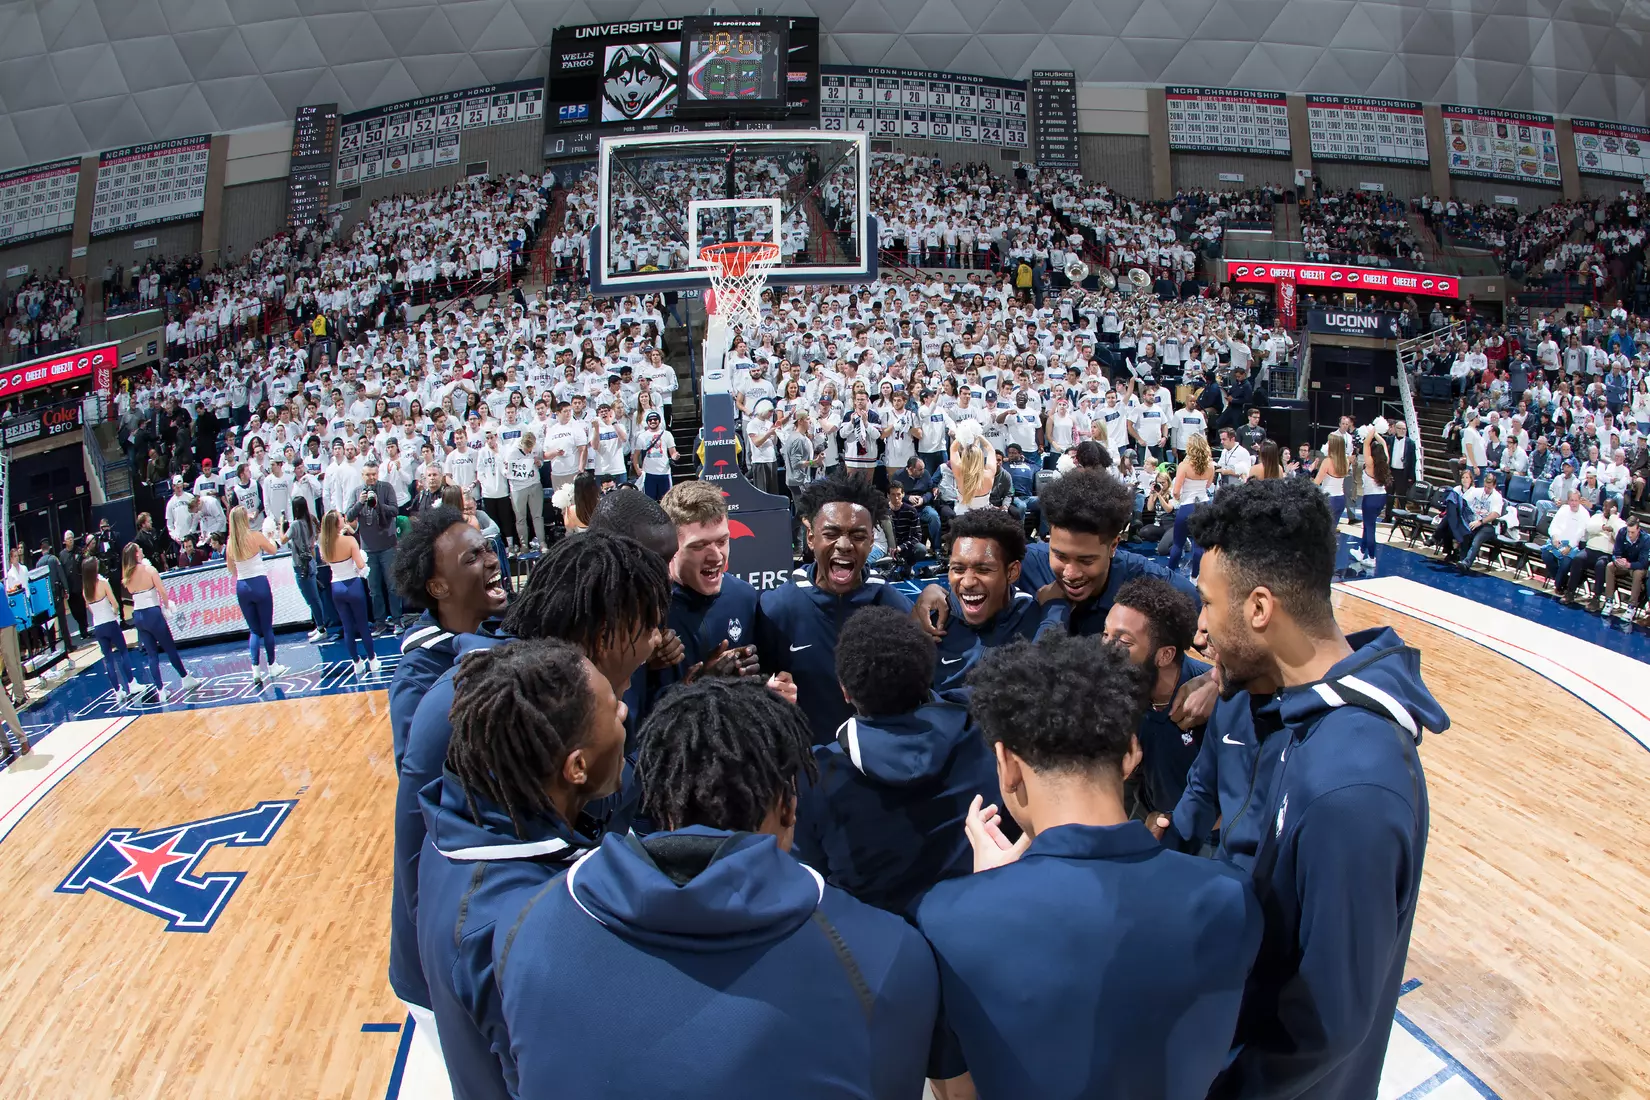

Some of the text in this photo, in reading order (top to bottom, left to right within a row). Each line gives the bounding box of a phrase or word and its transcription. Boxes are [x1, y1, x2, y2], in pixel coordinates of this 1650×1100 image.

[576, 20, 663, 38] UNIVERSITY
[562, 51, 595, 61] WELLS
[562, 60, 594, 69] FARGO
[901, 70, 938, 78] HUSKIES
[956, 75, 984, 83] HONOR
[828, 87, 839, 99] 32
[858, 88, 864, 100] 3
[909, 91, 920, 103] 20
[935, 93, 945, 105] 31
[1204, 89, 1280, 99] CHAMPIONSHIP
[382, 102, 410, 113] UCONN
[413, 94, 449, 106] HUSKIES
[467, 86, 496, 96] HONOR
[960, 95, 971, 107] 23
[985, 98, 996, 110] 31
[1343, 97, 1416, 109] CHAMPIONSHIP
[497, 106, 508, 118] 33
[525, 102, 535, 114] 10
[559, 103, 587, 115] CBS
[1009, 101, 1020, 112] 14
[469, 110, 482, 123] 25
[1448, 106, 1548, 122] NCAA CHAMPIONSHIP
[416, 119, 432, 132] 52
[441, 114, 458, 127] 42
[824, 118, 841, 130] 23
[857, 119, 865, 131] 4
[880, 120, 896, 132] 30
[392, 125, 405, 138] 21
[911, 122, 919, 133] 3
[933, 123, 948, 135] CD
[961, 126, 972, 137] 15
[366, 130, 382, 143] 50
[982, 128, 1000, 140] 24
[1008, 130, 1025, 142] 33
[106, 136, 205, 159] NCAA CHAMPIONSHIP
[342, 135, 359, 149] 24
[1270, 268, 1417, 288] CHEEZ-IT CHEEZ-IT CHEEZ-IT CHEEZ-IT
[1325, 313, 1378, 329] UCONN
[42, 407, 77, 427] Coke
[5, 419, 41, 439] BEAR'S
[49, 421, 73, 435] zero
[894, 430, 905, 441] 34
[705, 472, 738, 481] TRAVELERS
[168, 583, 194, 605] AM
